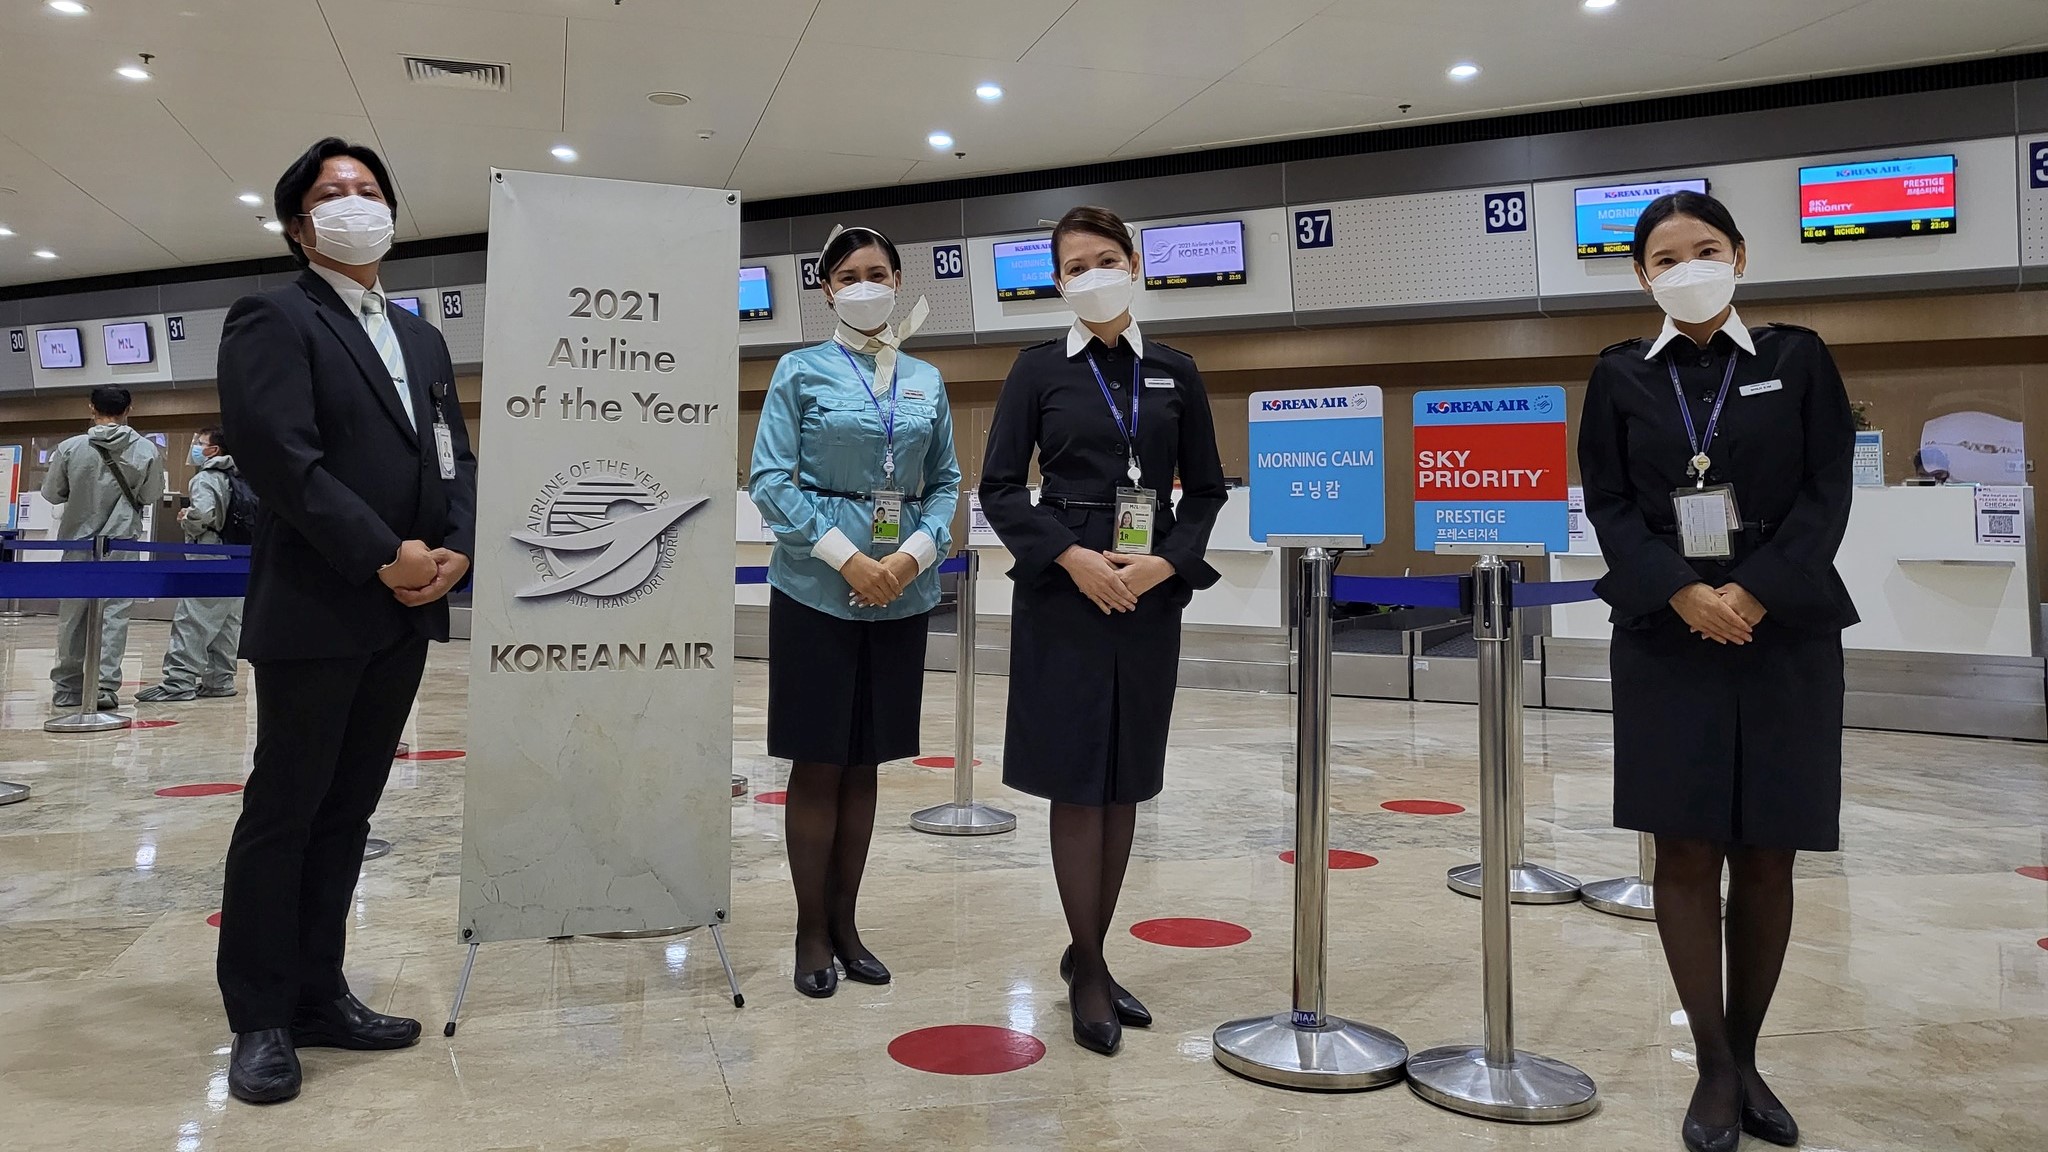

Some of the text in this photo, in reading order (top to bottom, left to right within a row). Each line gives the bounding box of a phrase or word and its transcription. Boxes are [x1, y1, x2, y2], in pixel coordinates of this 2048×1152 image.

[1836, 165, 1901, 178] KOREAN AIR
[1903, 177, 1944, 188] PRESTIGE
[1604, 188, 1660, 199] KOREAN AIR
[1488, 197, 1524, 228] 38
[1808, 203, 1852, 213] PRIORITY
[1299, 215, 1330, 244] 37
[1804, 229, 1827, 238] KE 624
[1834, 227, 1865, 236] INCHEON
[1930, 221, 1949, 230] 23:55
[1178, 245, 1237, 258] KOREAN AIR
[1603, 245, 1631, 253] INCHEON
[935, 249, 962, 276] 36
[443, 294, 462, 315] 33
[568, 287, 660, 322] 2021
[170, 319, 184, 338] 31
[11, 332, 24, 350] 30
[548, 336, 676, 374] Airline
[506, 385, 719, 425] of the Year
[1262, 398, 1318, 411] KOREAN
[1320, 396, 1348, 408] AIR
[1426, 400, 1496, 414] KOREAN
[1496, 399, 1530, 412] AIR
[1258, 450, 1374, 468] MORNING CALM
[1418, 450, 1471, 468] SKY
[1418, 469, 1543, 488] PRIORITY
[526, 459, 670, 534] AIRLINE OF THE YEAR
[1290, 480, 1341, 499] 모닝캄
[1436, 509, 1506, 523] PRESTIGE
[1436, 528, 1498, 541] 프레스티지석
[566, 592, 589, 608] AIR
[596, 573, 665, 609] TRANSPORT
[489, 642, 715, 673] KOREAN AIR
